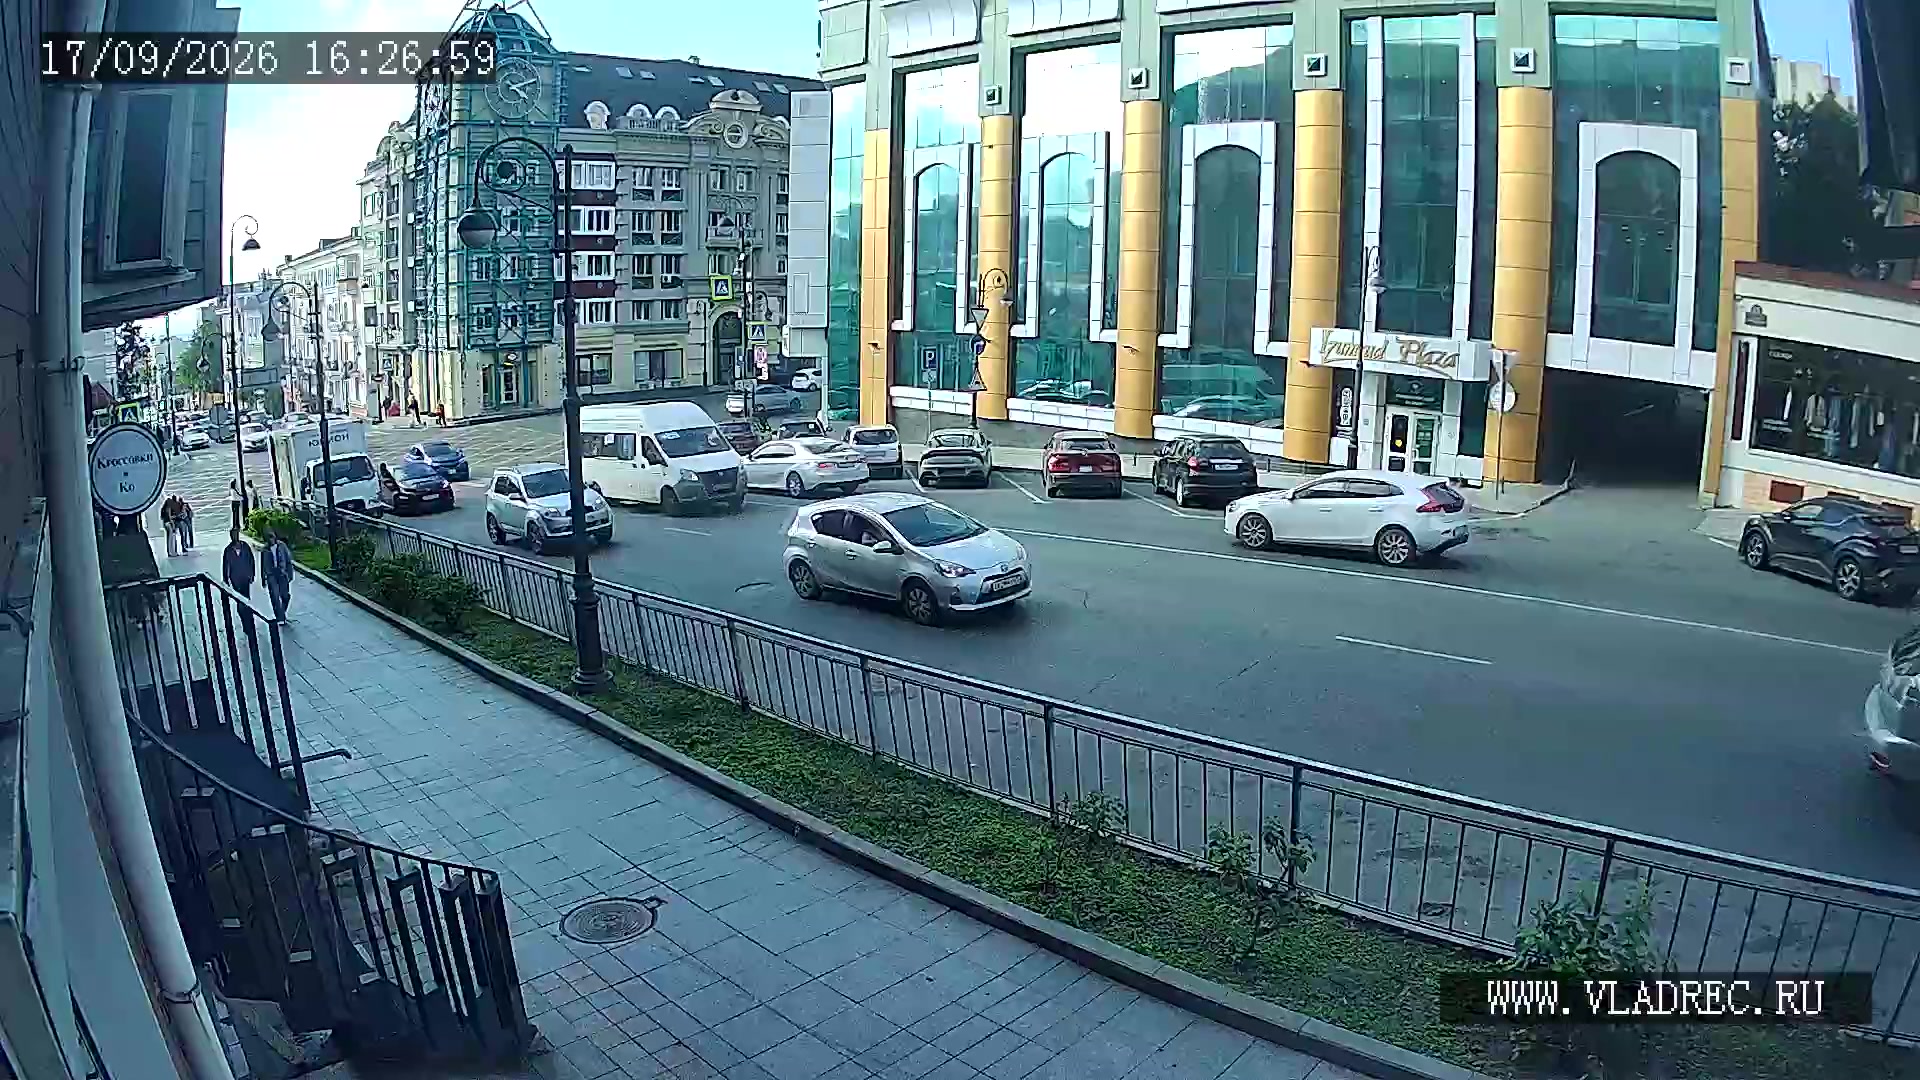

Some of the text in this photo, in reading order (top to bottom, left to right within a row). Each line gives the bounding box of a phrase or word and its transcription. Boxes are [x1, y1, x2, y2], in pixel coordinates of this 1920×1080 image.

[1319, 330, 1460, 368] Izumud Plaza
[97, 453, 153, 469] Кроссовки
[119, 481, 136, 493] Ко
